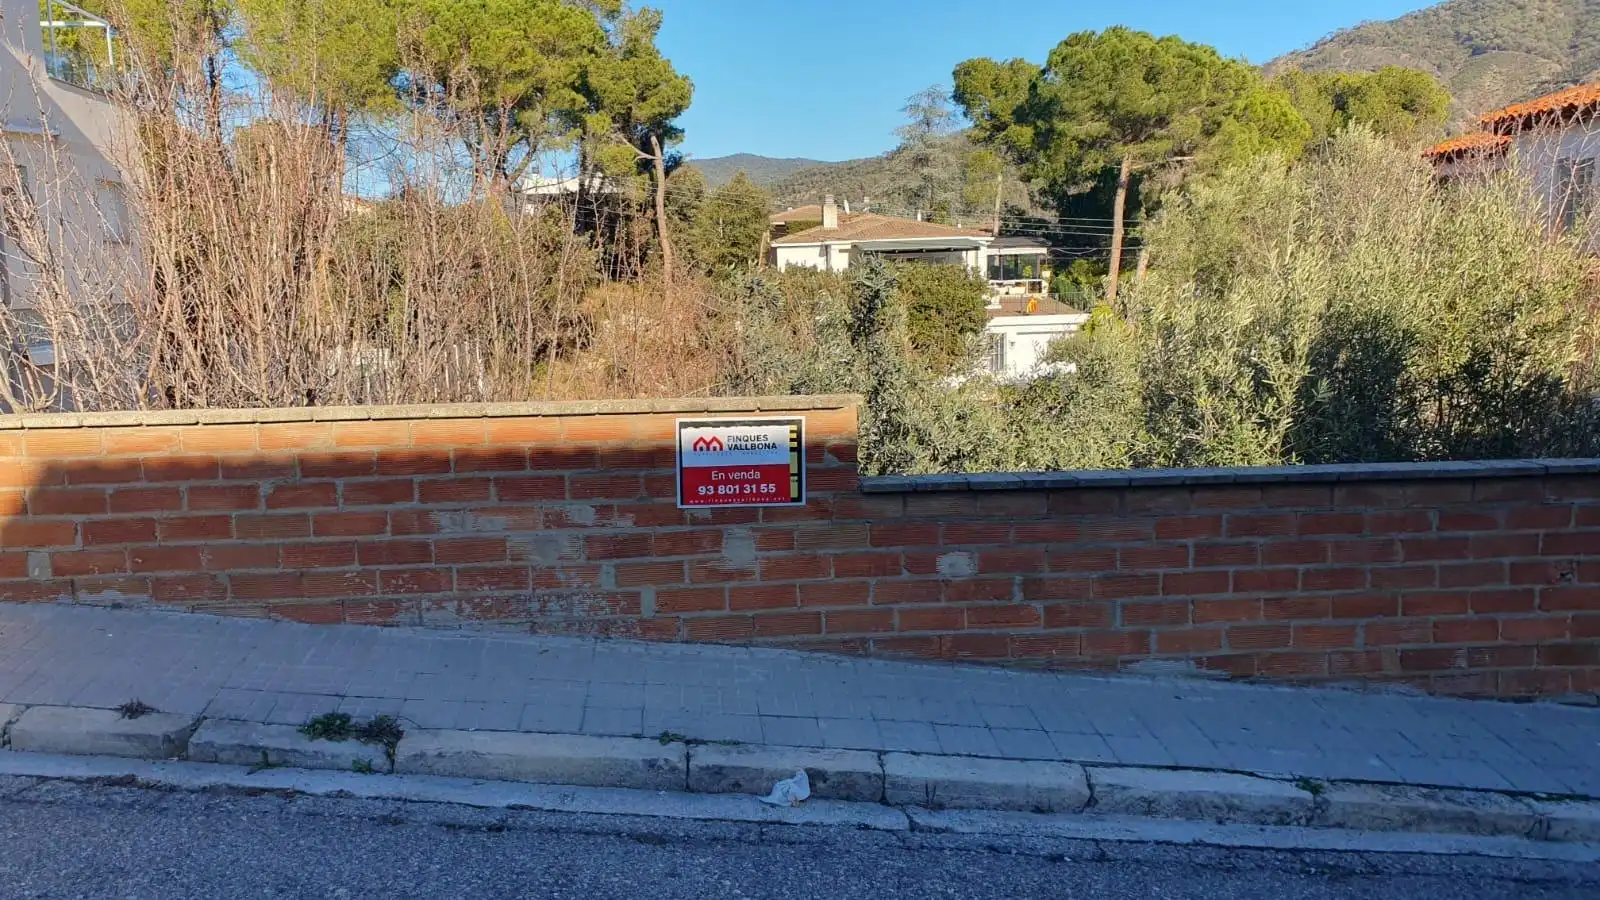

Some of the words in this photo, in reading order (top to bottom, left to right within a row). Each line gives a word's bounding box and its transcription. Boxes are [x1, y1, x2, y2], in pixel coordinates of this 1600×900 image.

[727, 434, 769, 442] FINQUES
[727, 442, 778, 451] VALLBONA
[711, 471, 725, 480] En
[728, 469, 761, 480] venda
[698, 486, 714, 495] 93
[717, 485, 739, 495] 801
[743, 484, 757, 494] 31
[760, 483, 776, 493] 55
